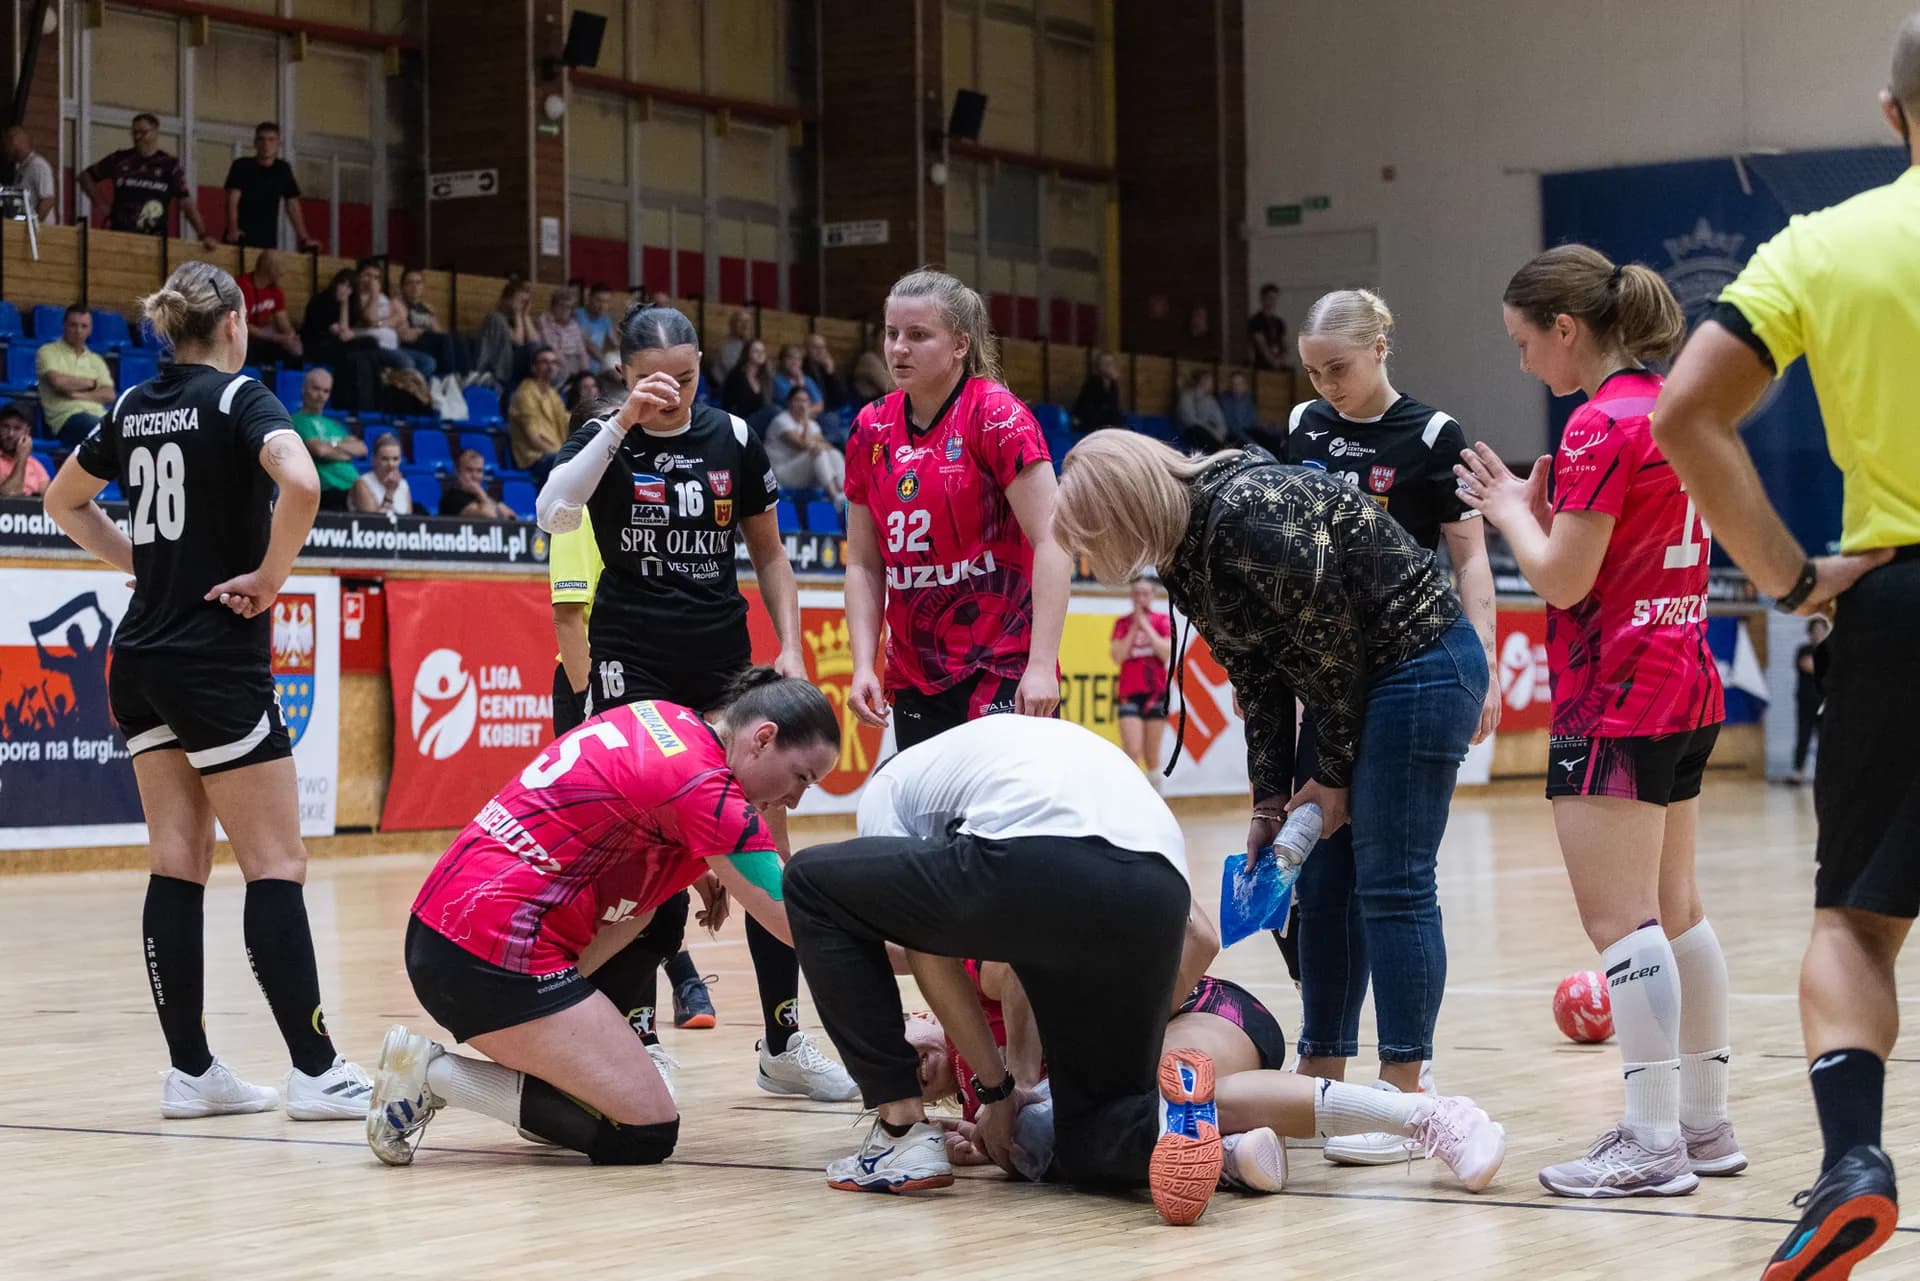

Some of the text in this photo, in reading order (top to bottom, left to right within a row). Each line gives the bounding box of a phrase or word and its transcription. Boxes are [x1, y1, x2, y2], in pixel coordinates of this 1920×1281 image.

[122, 407, 199, 438] GRYCZEWSKA
[129, 442, 186, 545] 28
[674, 480, 704, 517] 16
[621, 527, 657, 553] SPR
[887, 509, 931, 552] 32
[479, 666, 521, 690] LIGA
[599, 660, 625, 699] 16
[45, 741, 68, 760] na
[479, 723, 542, 748] KOBIET
[520, 721, 630, 790] 5
[147, 937, 166, 1006] SPR OLKUSZ
[1629, 965, 1660, 981] cep
